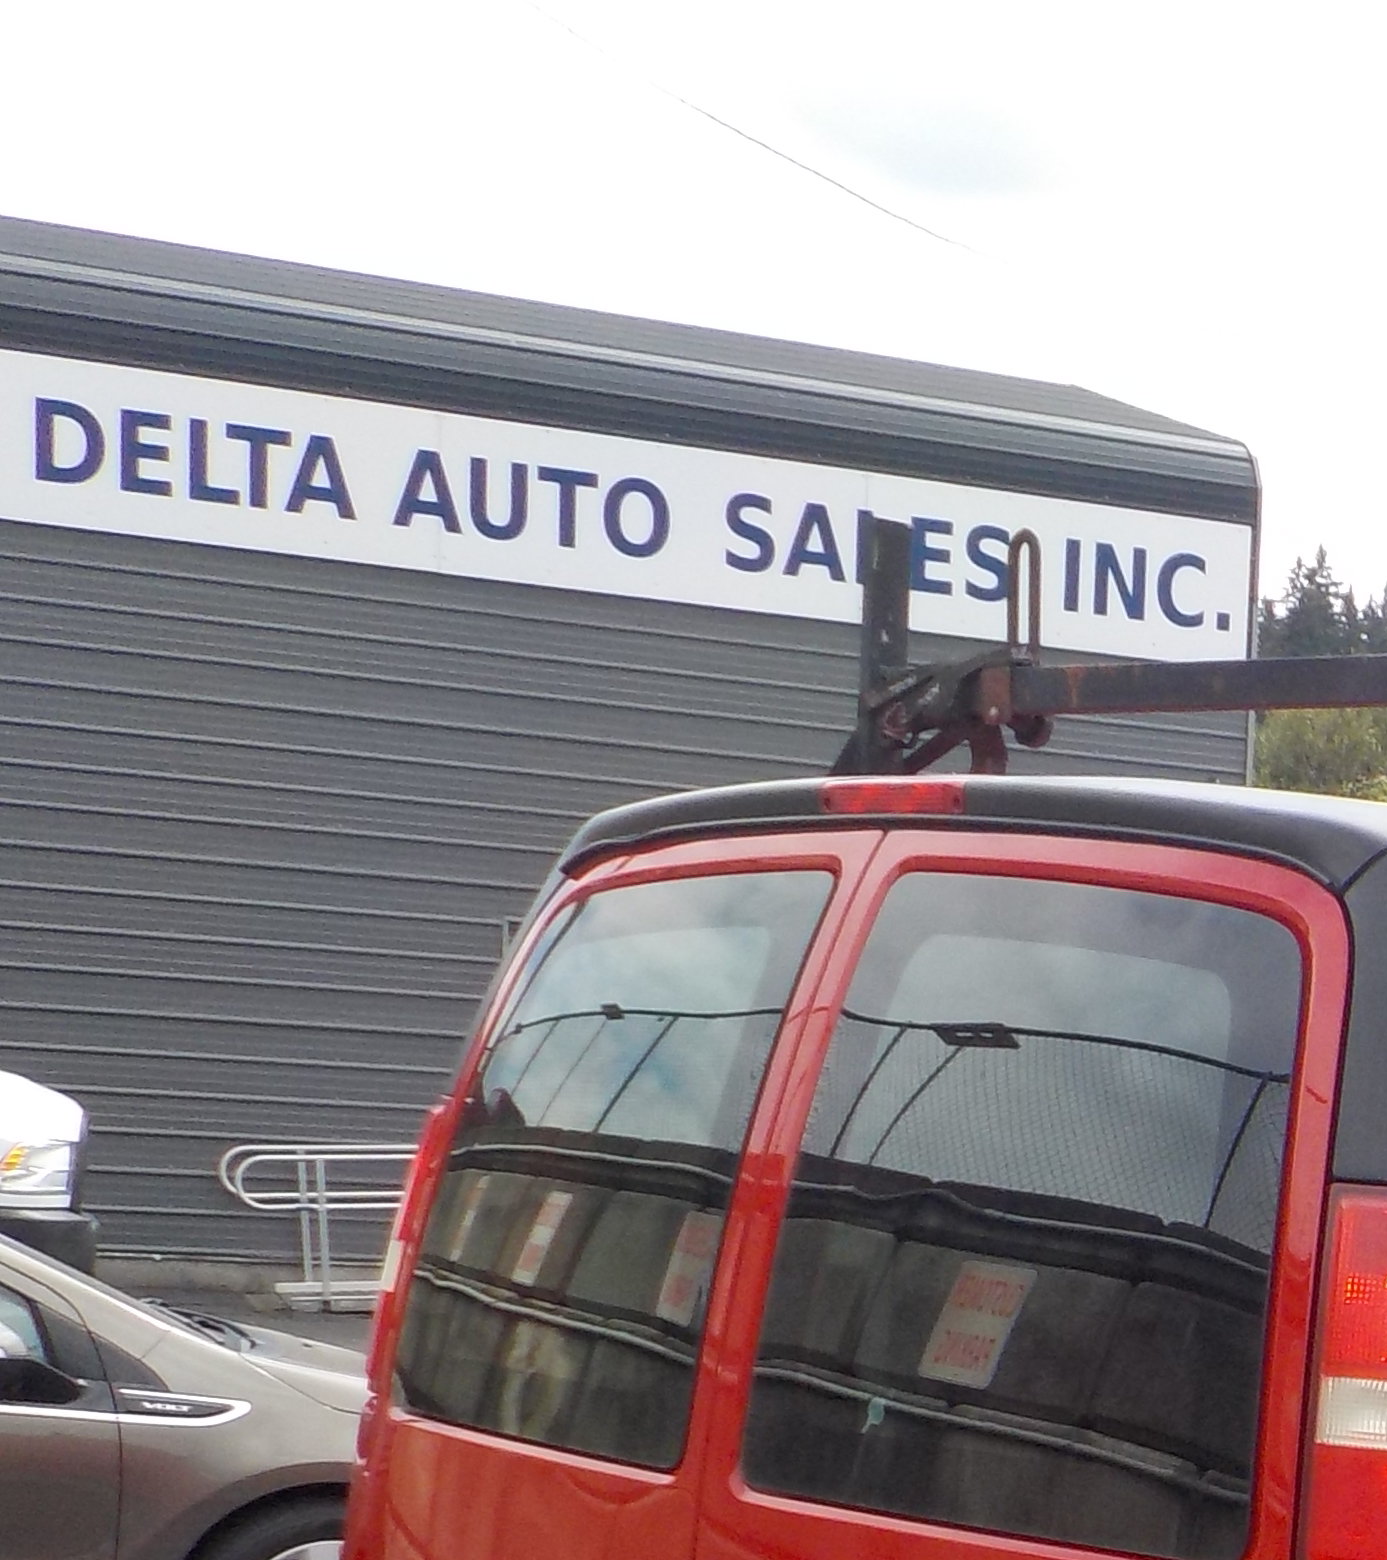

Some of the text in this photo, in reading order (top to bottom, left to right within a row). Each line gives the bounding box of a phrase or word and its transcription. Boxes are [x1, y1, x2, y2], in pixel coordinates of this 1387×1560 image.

[33, 396, 358, 521] DELTA
[392, 448, 671, 558] AUTO
[1063, 538, 1232, 632] INC.
